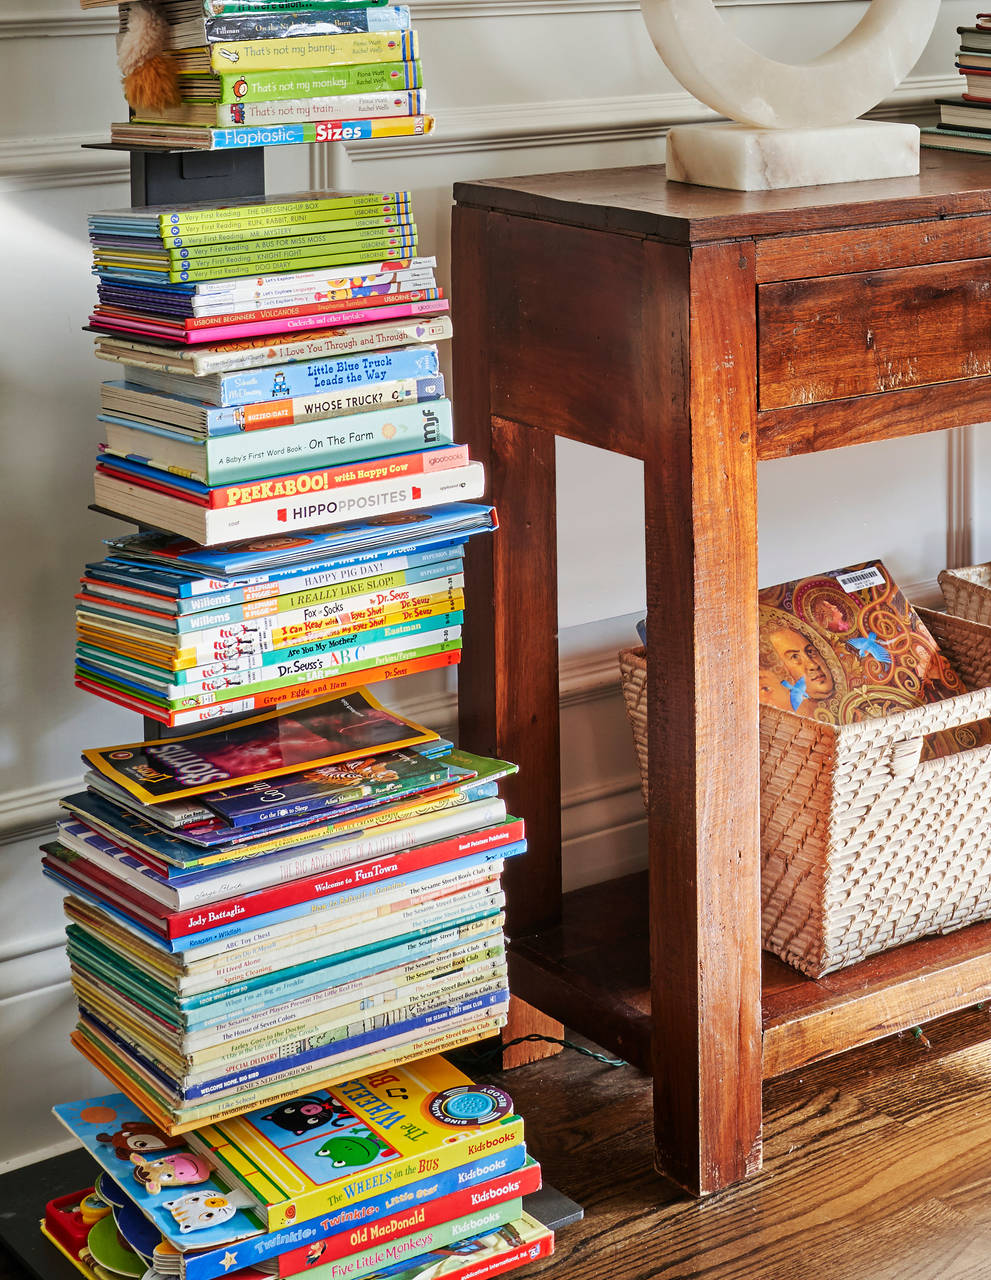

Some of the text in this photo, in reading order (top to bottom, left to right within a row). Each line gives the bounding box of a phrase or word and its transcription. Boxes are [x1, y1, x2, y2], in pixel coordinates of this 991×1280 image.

[244, 45, 271, 57] That's
[273, 47, 288, 55] not
[291, 46, 305, 56] my
[308, 43, 343, 54] bunny...
[224, 124, 362, 145] Flaptastic Sizes
[265, 228, 292, 236] MYSTERY
[276, 238, 288, 246] FOR
[290, 237, 306, 245] MISS
[257, 249, 302, 260] KNIGHT FIGHT
[307, 356, 392, 378] Little Blue Truck
[314, 369, 388, 388] Leads the Way
[304, 400, 343, 415] WHOSE
[346, 392, 383, 408] TRUCK?
[226, 473, 329, 507] PEEKABOO!
[334, 472, 356, 484] with
[357, 466, 387, 482] Happy
[389, 462, 408, 474] Cow
[292, 490, 407, 520] HIPPOPPOSITES
[191, 562, 384, 610] Willems HAPPY PIG DAY!
[303, 590, 410, 620] Fox Socks Dr. Seuss
[187, 916, 208, 928] Jody
[208, 904, 245, 923] Battaglia
[314, 880, 345, 893] Welcome
[458, 843, 471, 851] Small
[488, 832, 509, 843] Publishing
[420, 988, 440, 997] Sesame
[441, 983, 456, 991] Street
[457, 979, 470, 987] Book
[472, 975, 484, 983] Club
[225, 1052, 278, 1073] SPECIAL DELIVERY
[326, 1132, 516, 1207] The WHEELS on the BUS Kidsbooks
[350, 1181, 520, 1247] Old MacDonald Kidsbooks
[331, 1211, 500, 1278] Five Little Monkeys Kidsbooks
